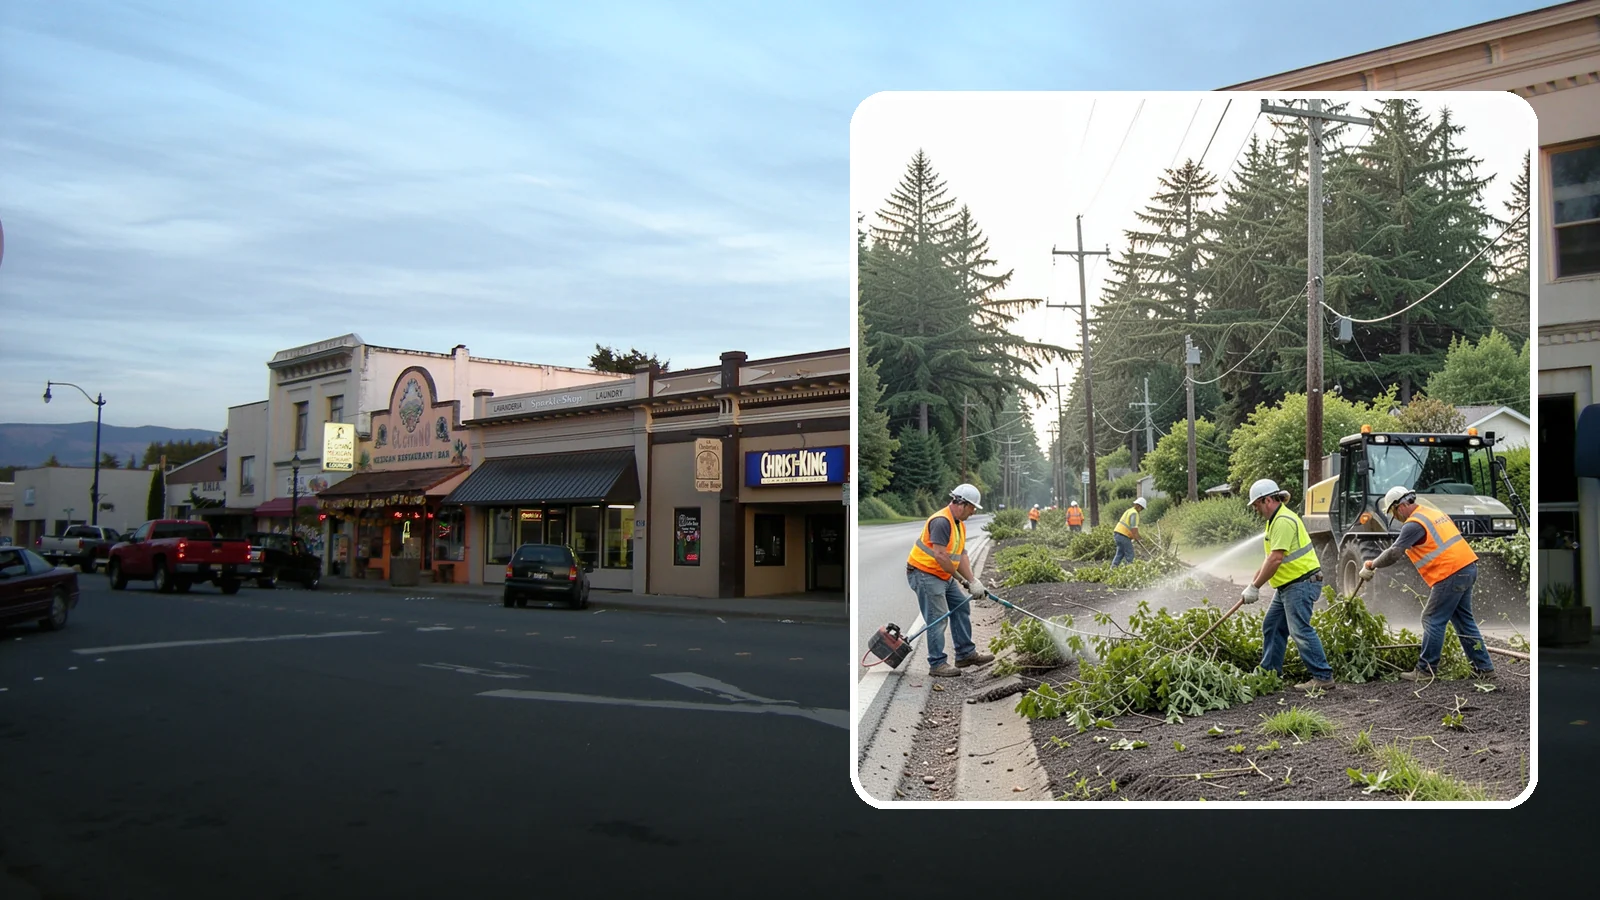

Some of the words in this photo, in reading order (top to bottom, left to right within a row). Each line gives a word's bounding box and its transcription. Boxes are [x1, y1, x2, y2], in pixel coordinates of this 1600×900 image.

[493, 402, 522, 412] LAVANDERIA
[595, 389, 623, 400] LAUNDRY
[373, 455, 396, 464] MEXICAN
[397, 452, 434, 462] RESTAURANT
[438, 450, 450, 458] BAR
[760, 452, 797, 478] CHRIST
[799, 450, 827, 476] KING
